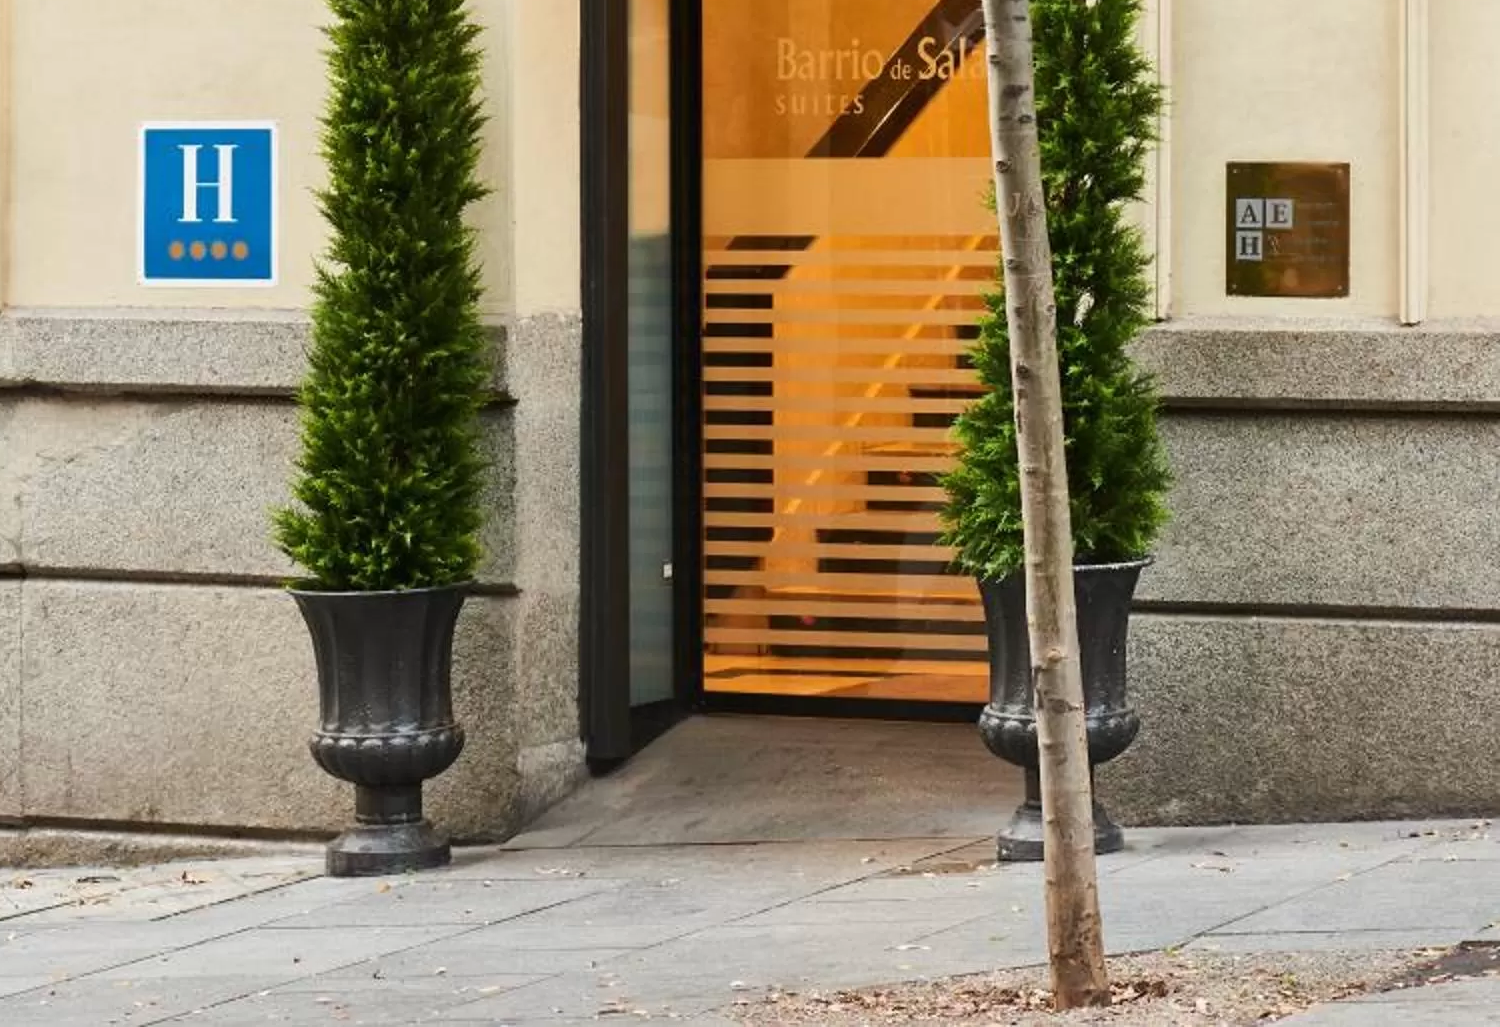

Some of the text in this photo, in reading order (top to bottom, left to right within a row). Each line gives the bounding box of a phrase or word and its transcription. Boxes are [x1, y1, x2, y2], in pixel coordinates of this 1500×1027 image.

[778, 38, 884, 80] Barrio
[891, 59, 911, 80] de
[177, 144, 239, 223] H
